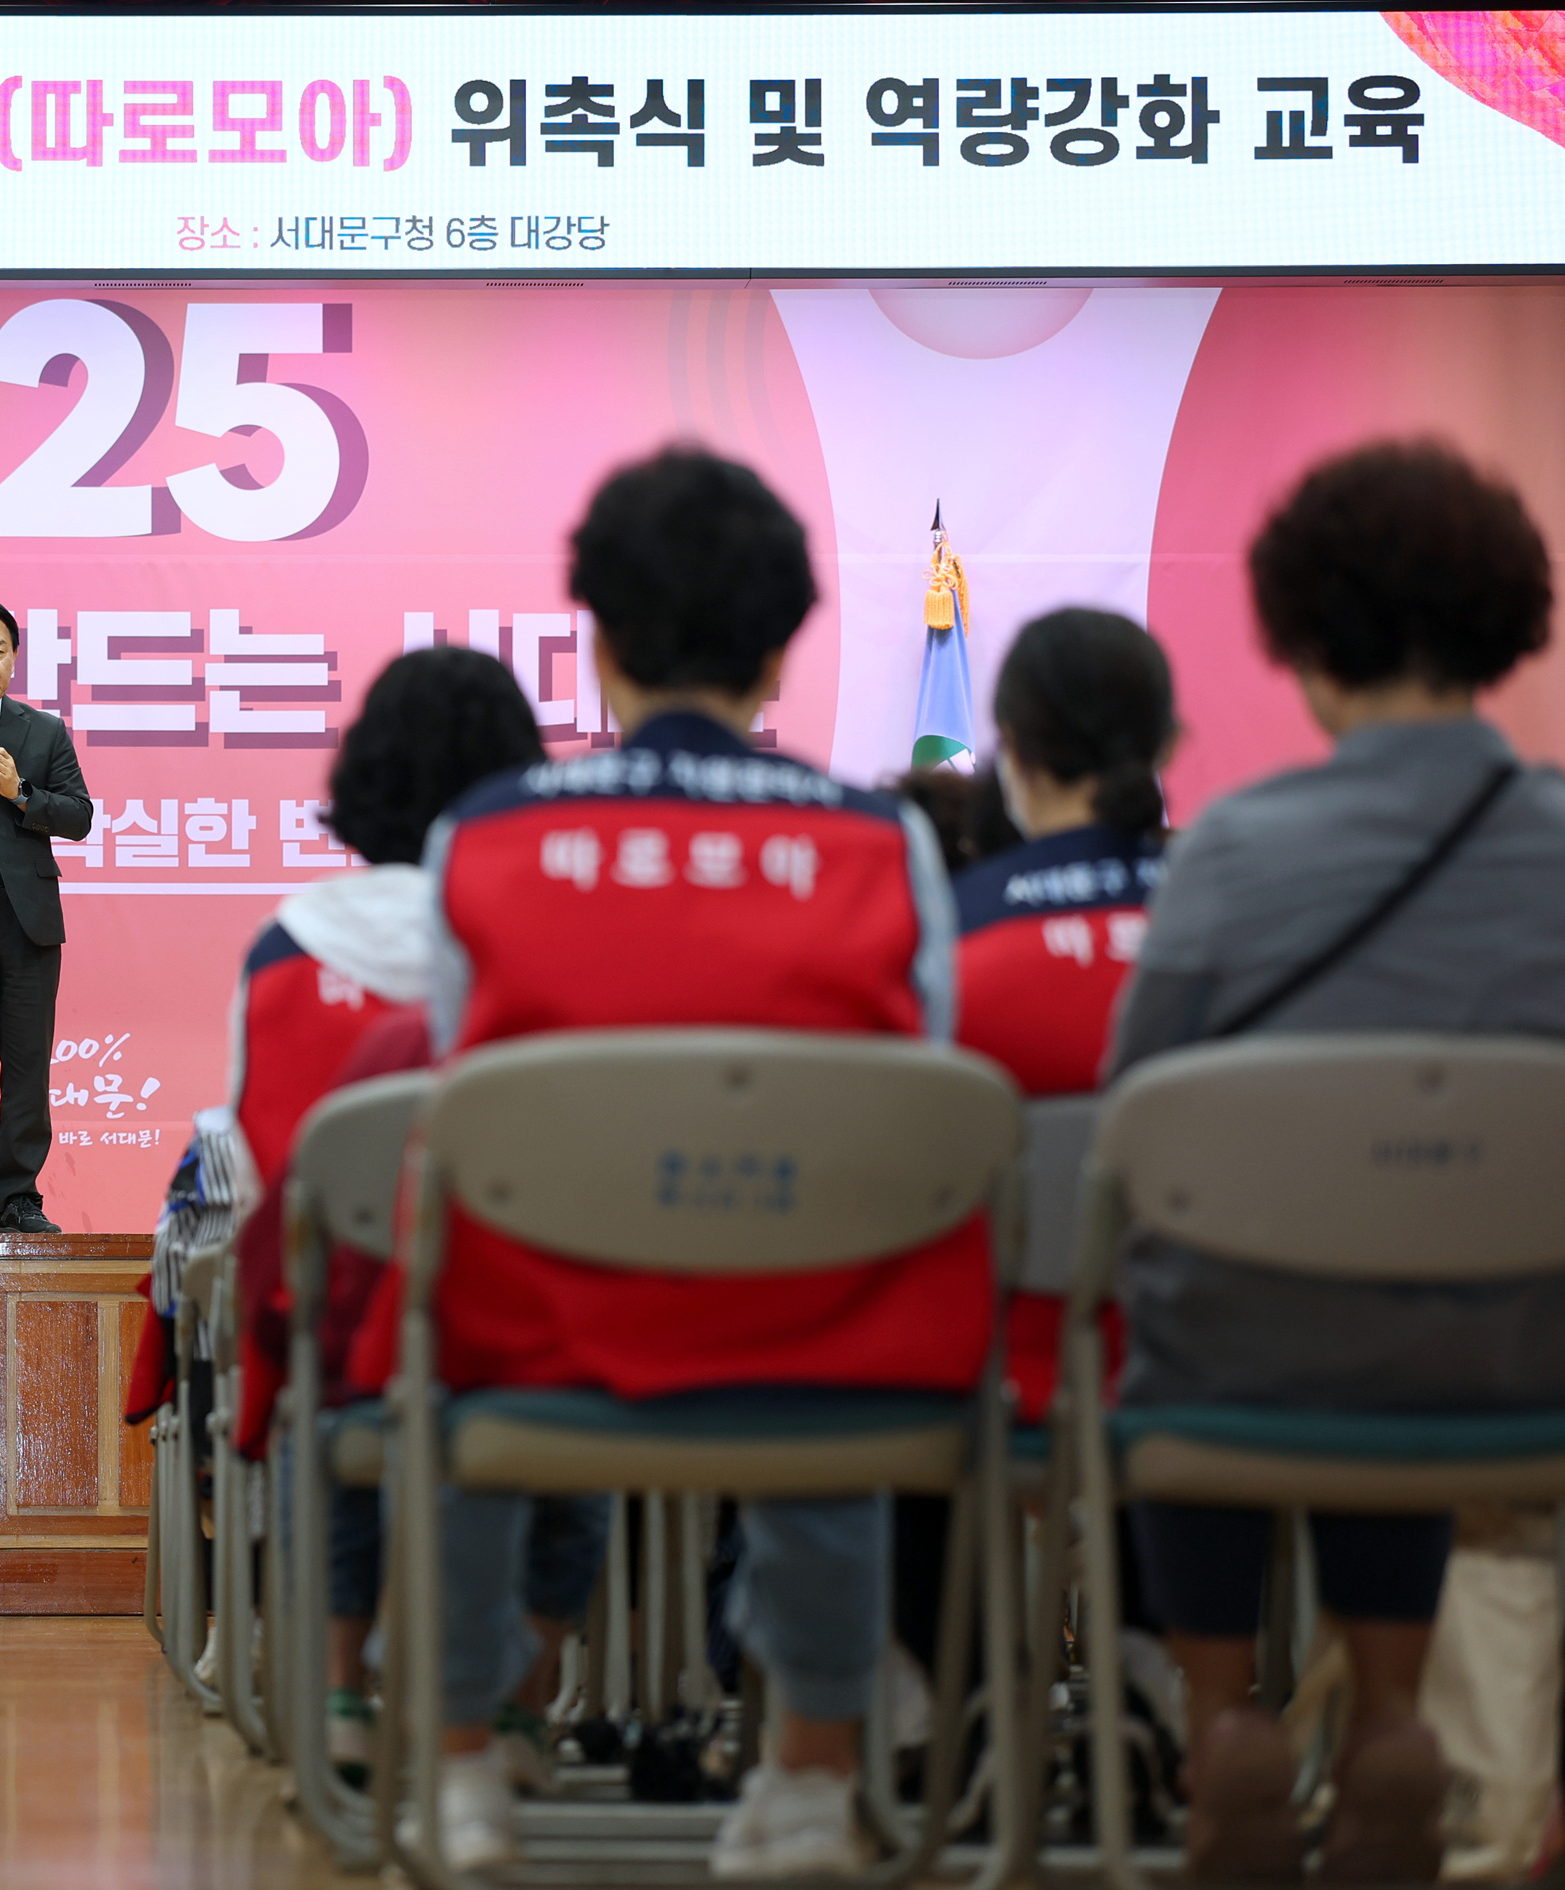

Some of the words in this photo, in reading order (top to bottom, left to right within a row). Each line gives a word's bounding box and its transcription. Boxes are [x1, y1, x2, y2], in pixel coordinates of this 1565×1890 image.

[451, 75, 706, 167] 위촉식
[749, 79, 825, 167] 및
[867, 74, 1220, 167] 역량강화
[1253, 74, 1426, 164] 교육
[177, 215, 241, 250] 장소
[270, 215, 434, 251] 서대문구청
[446, 215, 499, 251] 6층
[510, 215, 611, 251] 대강당
[58, 1130, 93, 1147] 바로
[100, 1129, 161, 1148] 서대문!
